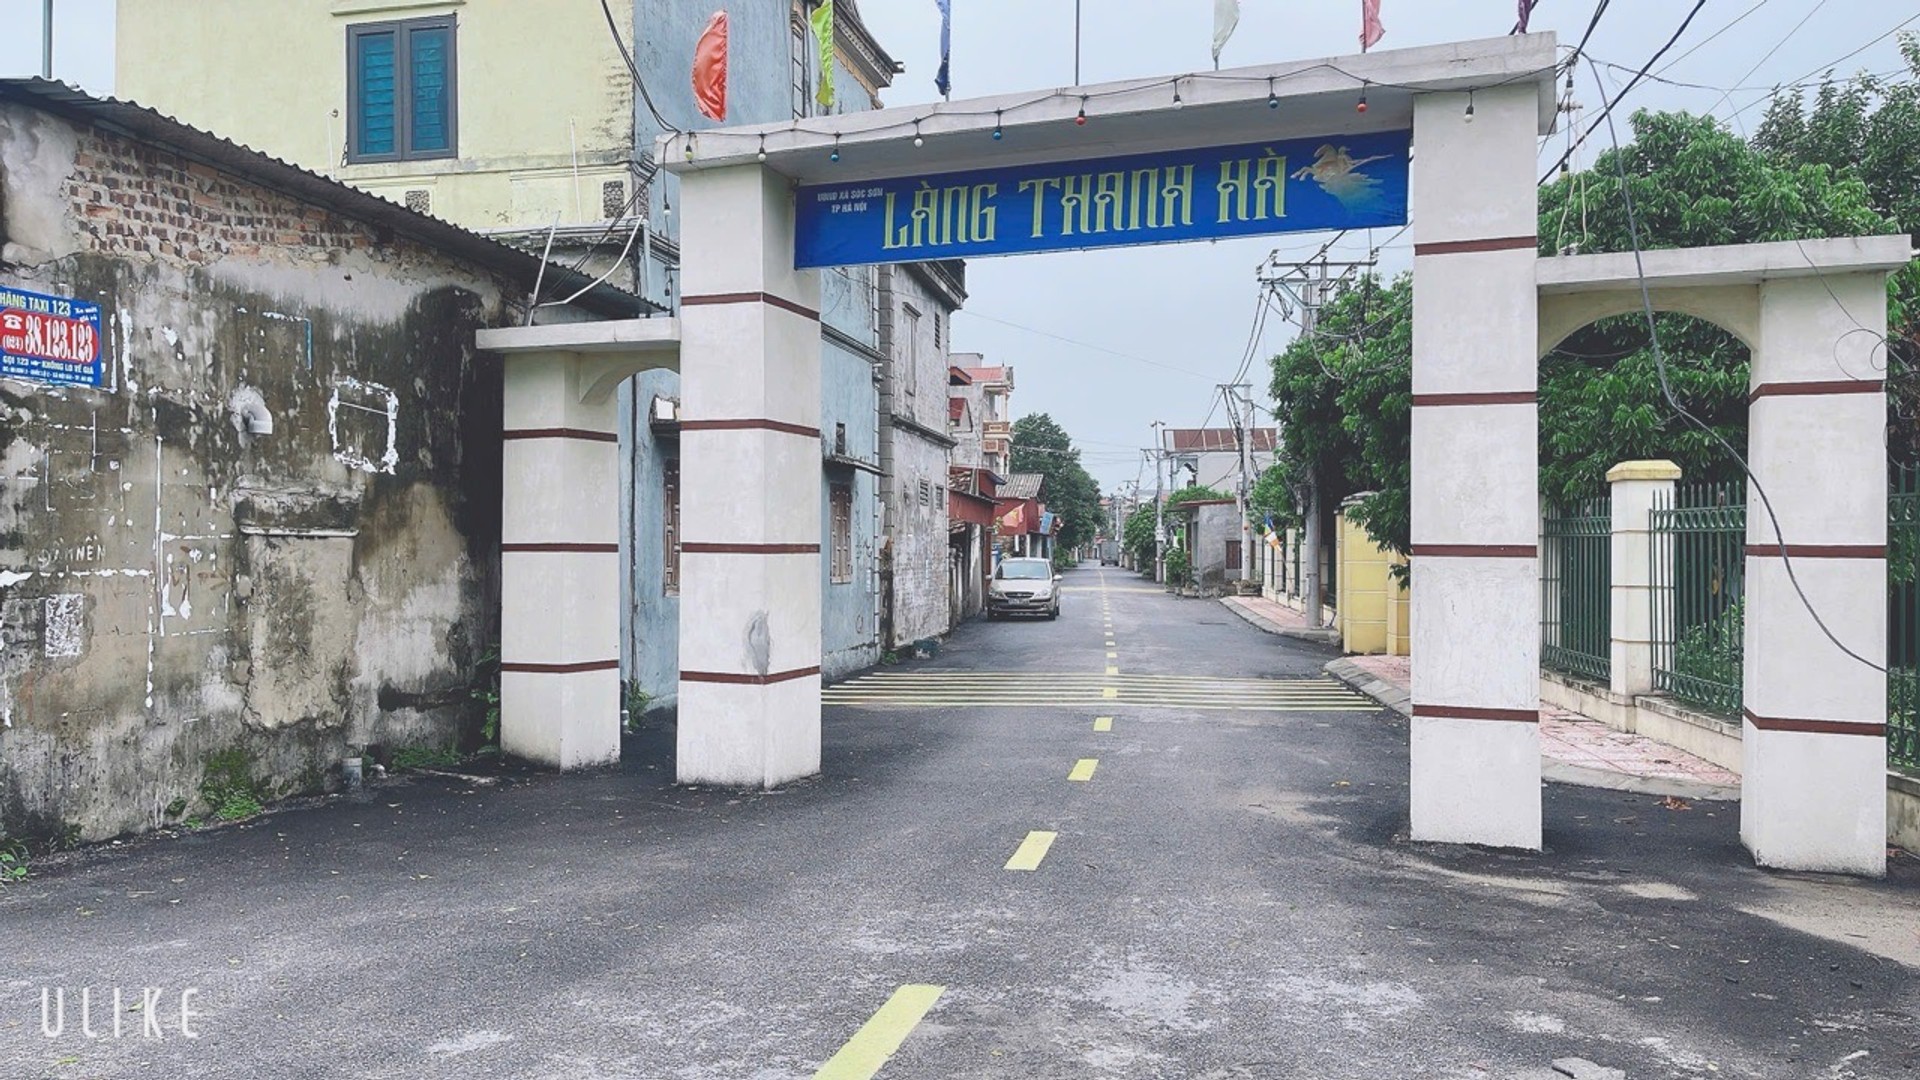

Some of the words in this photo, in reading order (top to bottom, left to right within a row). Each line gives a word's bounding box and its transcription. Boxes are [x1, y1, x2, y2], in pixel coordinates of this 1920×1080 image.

[882, 180, 998, 250] LÀNG
[1018, 164, 1195, 239] THANH
[1216, 147, 1287, 223] HÀ
[28, 297, 49, 311] TAXI
[53, 300, 71, 317] 123
[26, 315, 93, 362] 38.123.123
